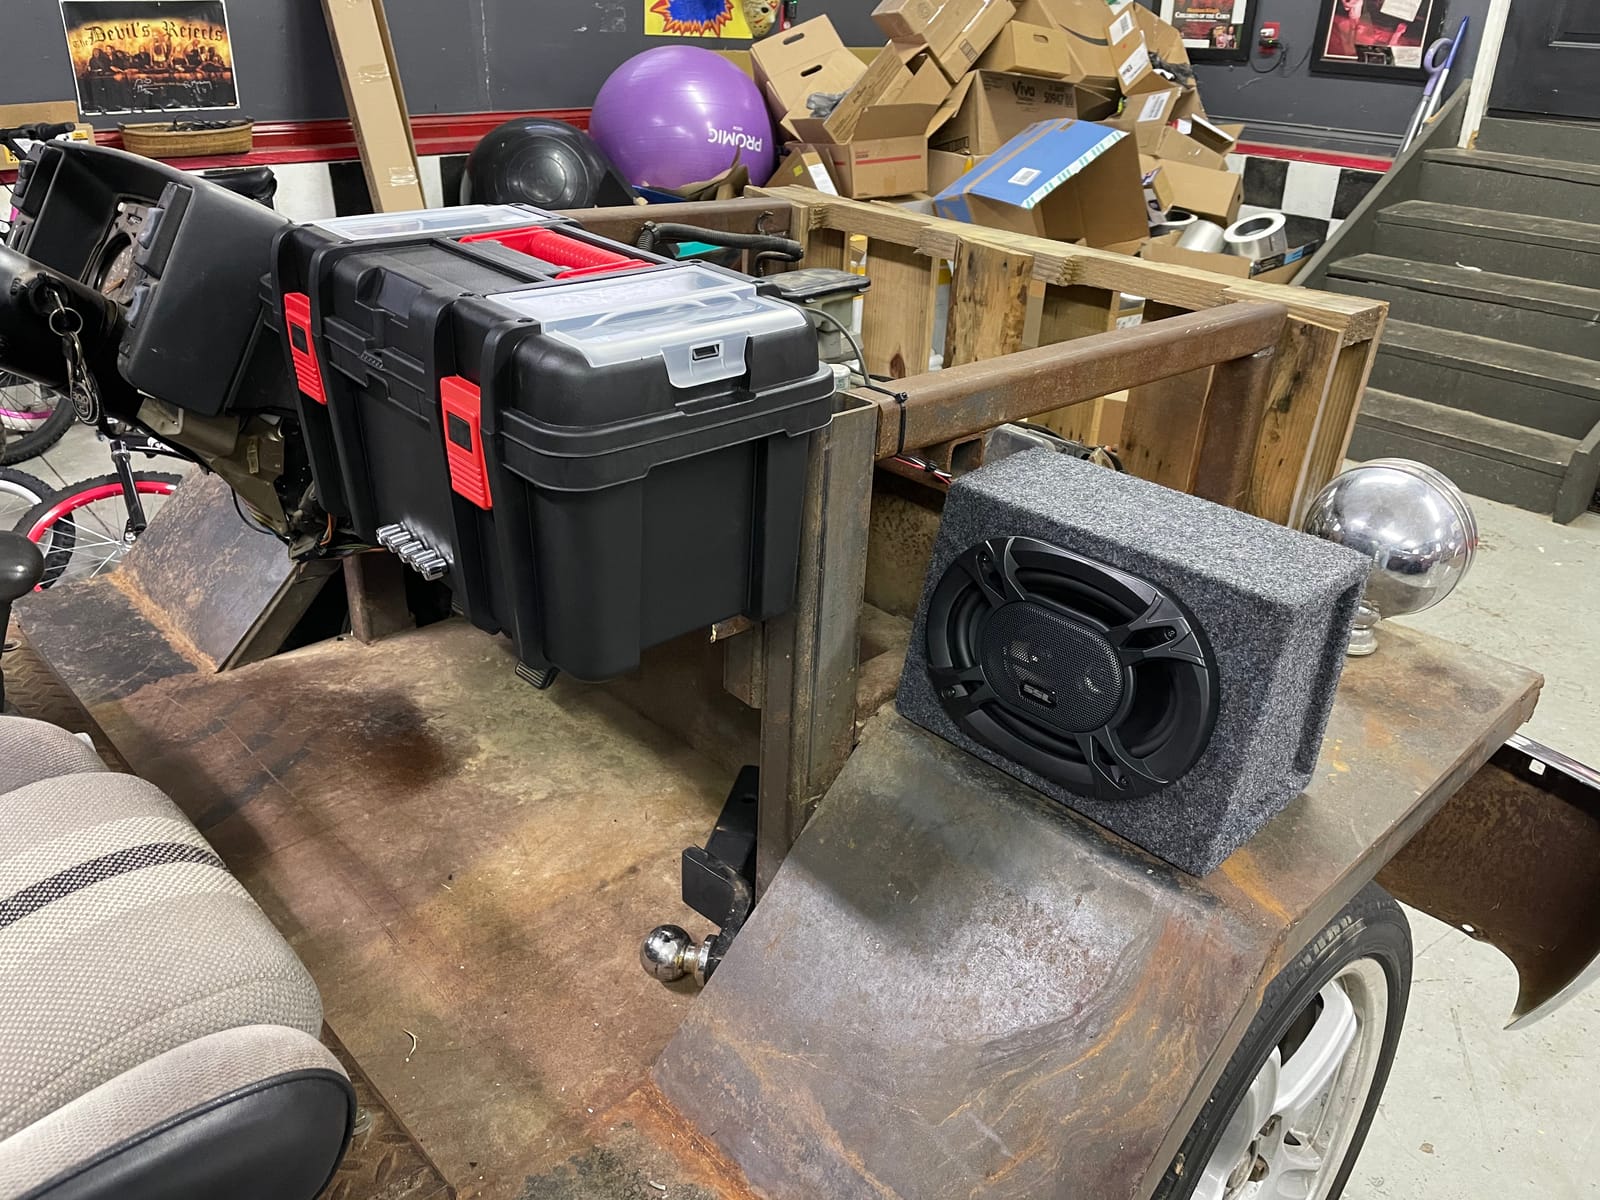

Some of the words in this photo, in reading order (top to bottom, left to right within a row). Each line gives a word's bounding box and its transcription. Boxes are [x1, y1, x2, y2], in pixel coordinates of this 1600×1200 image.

[84, 21, 151, 45] Devil's
[162, 20, 225, 42] Rejects
[707, 127, 763, 153] PROMIC
